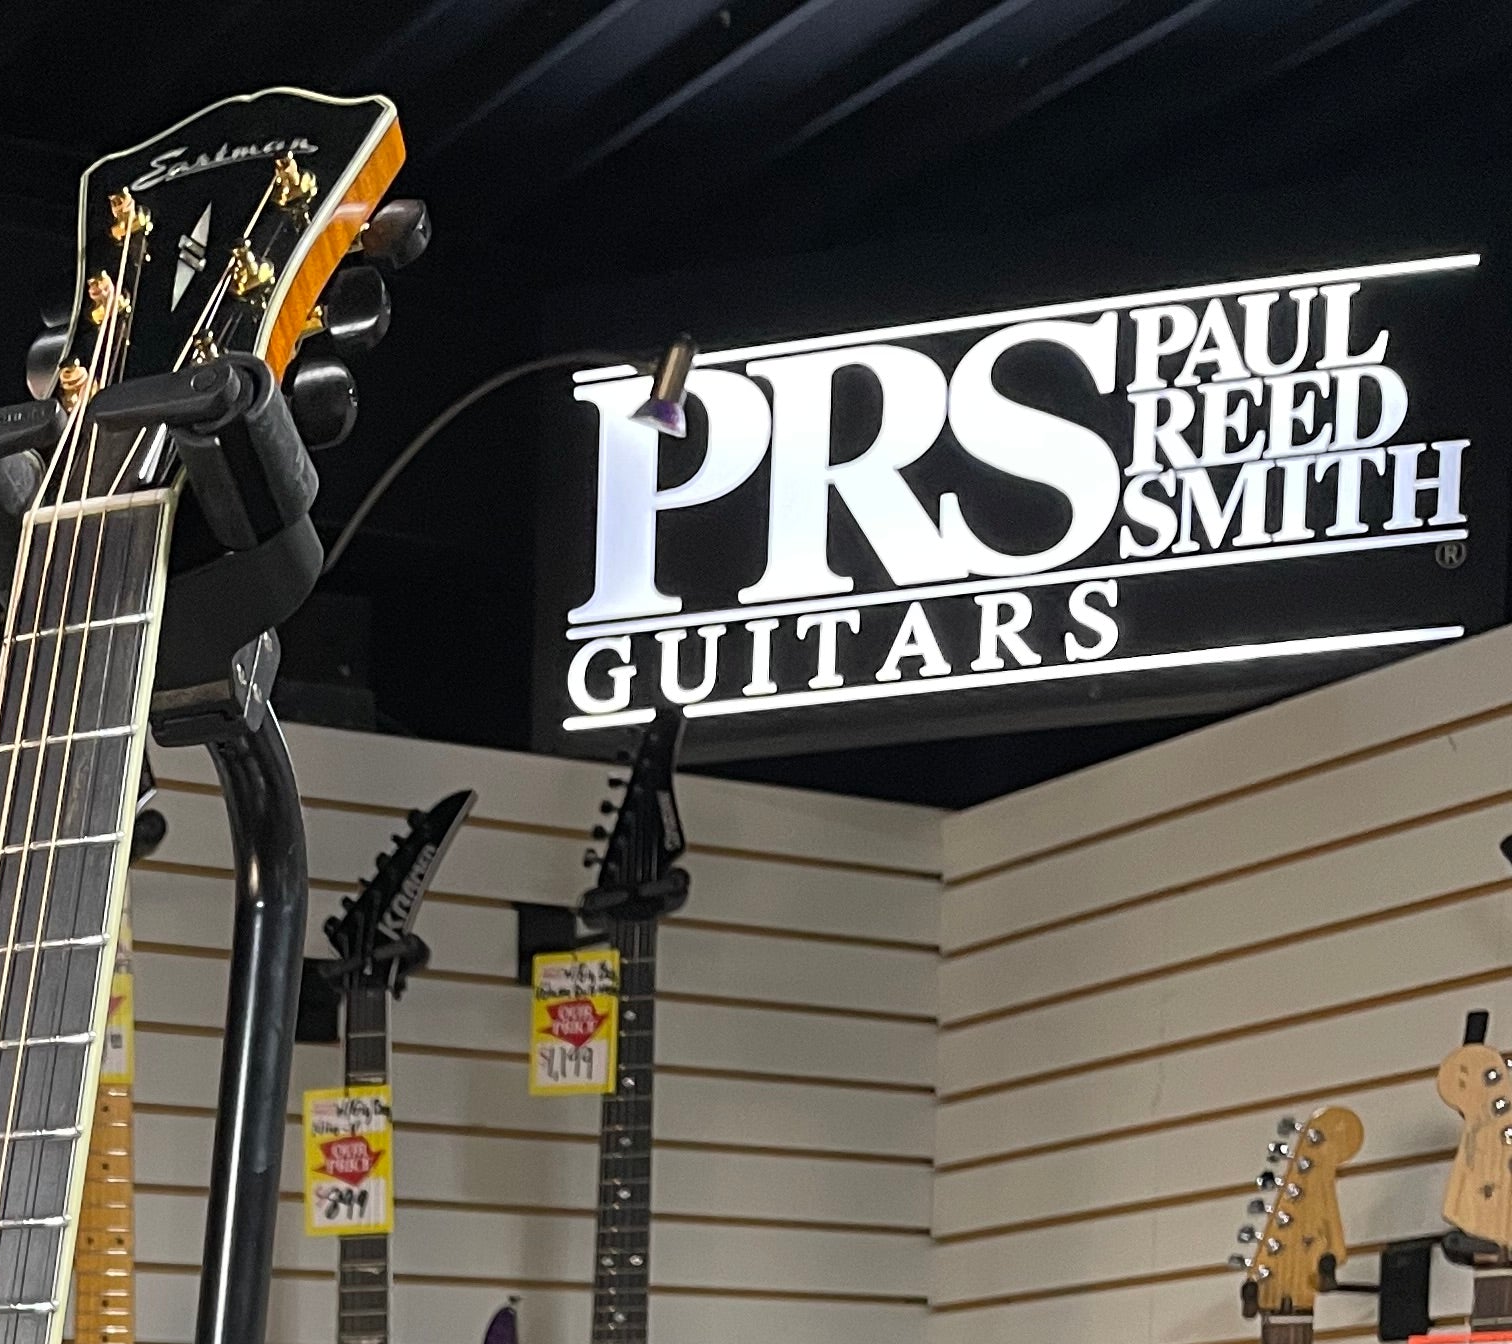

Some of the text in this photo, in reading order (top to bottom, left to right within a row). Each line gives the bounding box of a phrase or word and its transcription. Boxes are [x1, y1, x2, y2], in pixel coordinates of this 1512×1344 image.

[131, 138, 319, 192] Eastman
[1128, 282, 1390, 394] PAUL
[568, 310, 1121, 624] PRS
[1127, 364, 1409, 478] REED
[1118, 438, 1471, 560] SMITH
[566, 579, 1120, 715] GUITARS
